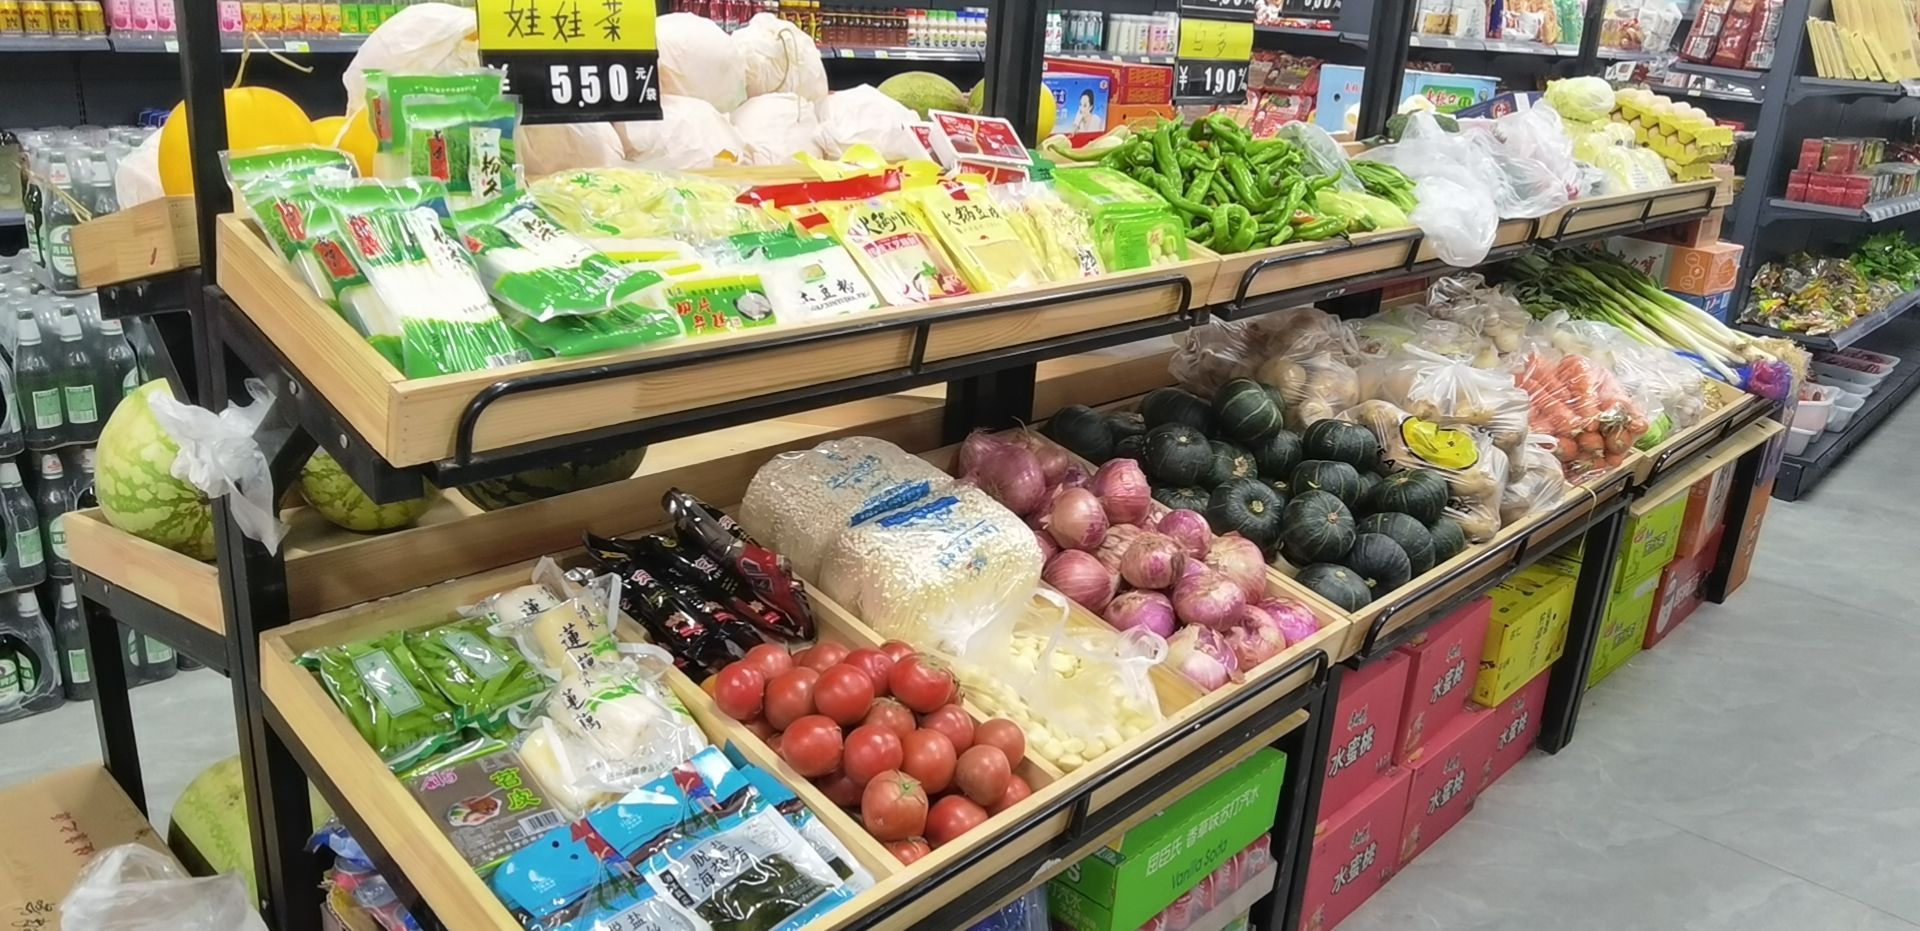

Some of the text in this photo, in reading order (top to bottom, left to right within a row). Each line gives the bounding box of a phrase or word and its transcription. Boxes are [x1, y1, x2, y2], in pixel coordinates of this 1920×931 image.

[504, 0, 623, 43] 娃娃菜
[550, 64, 629, 108] 5.50
[1431, 658, 1466, 705] 水蜜桃
[1328, 724, 1376, 778] 水蜜桃
[1497, 712, 1528, 751] 水蜜桃
[1426, 770, 1466, 816] 水蜜桃
[1171, 839, 1228, 890] Vanilla Soda
[1330, 843, 1377, 896] 水蜜桃
